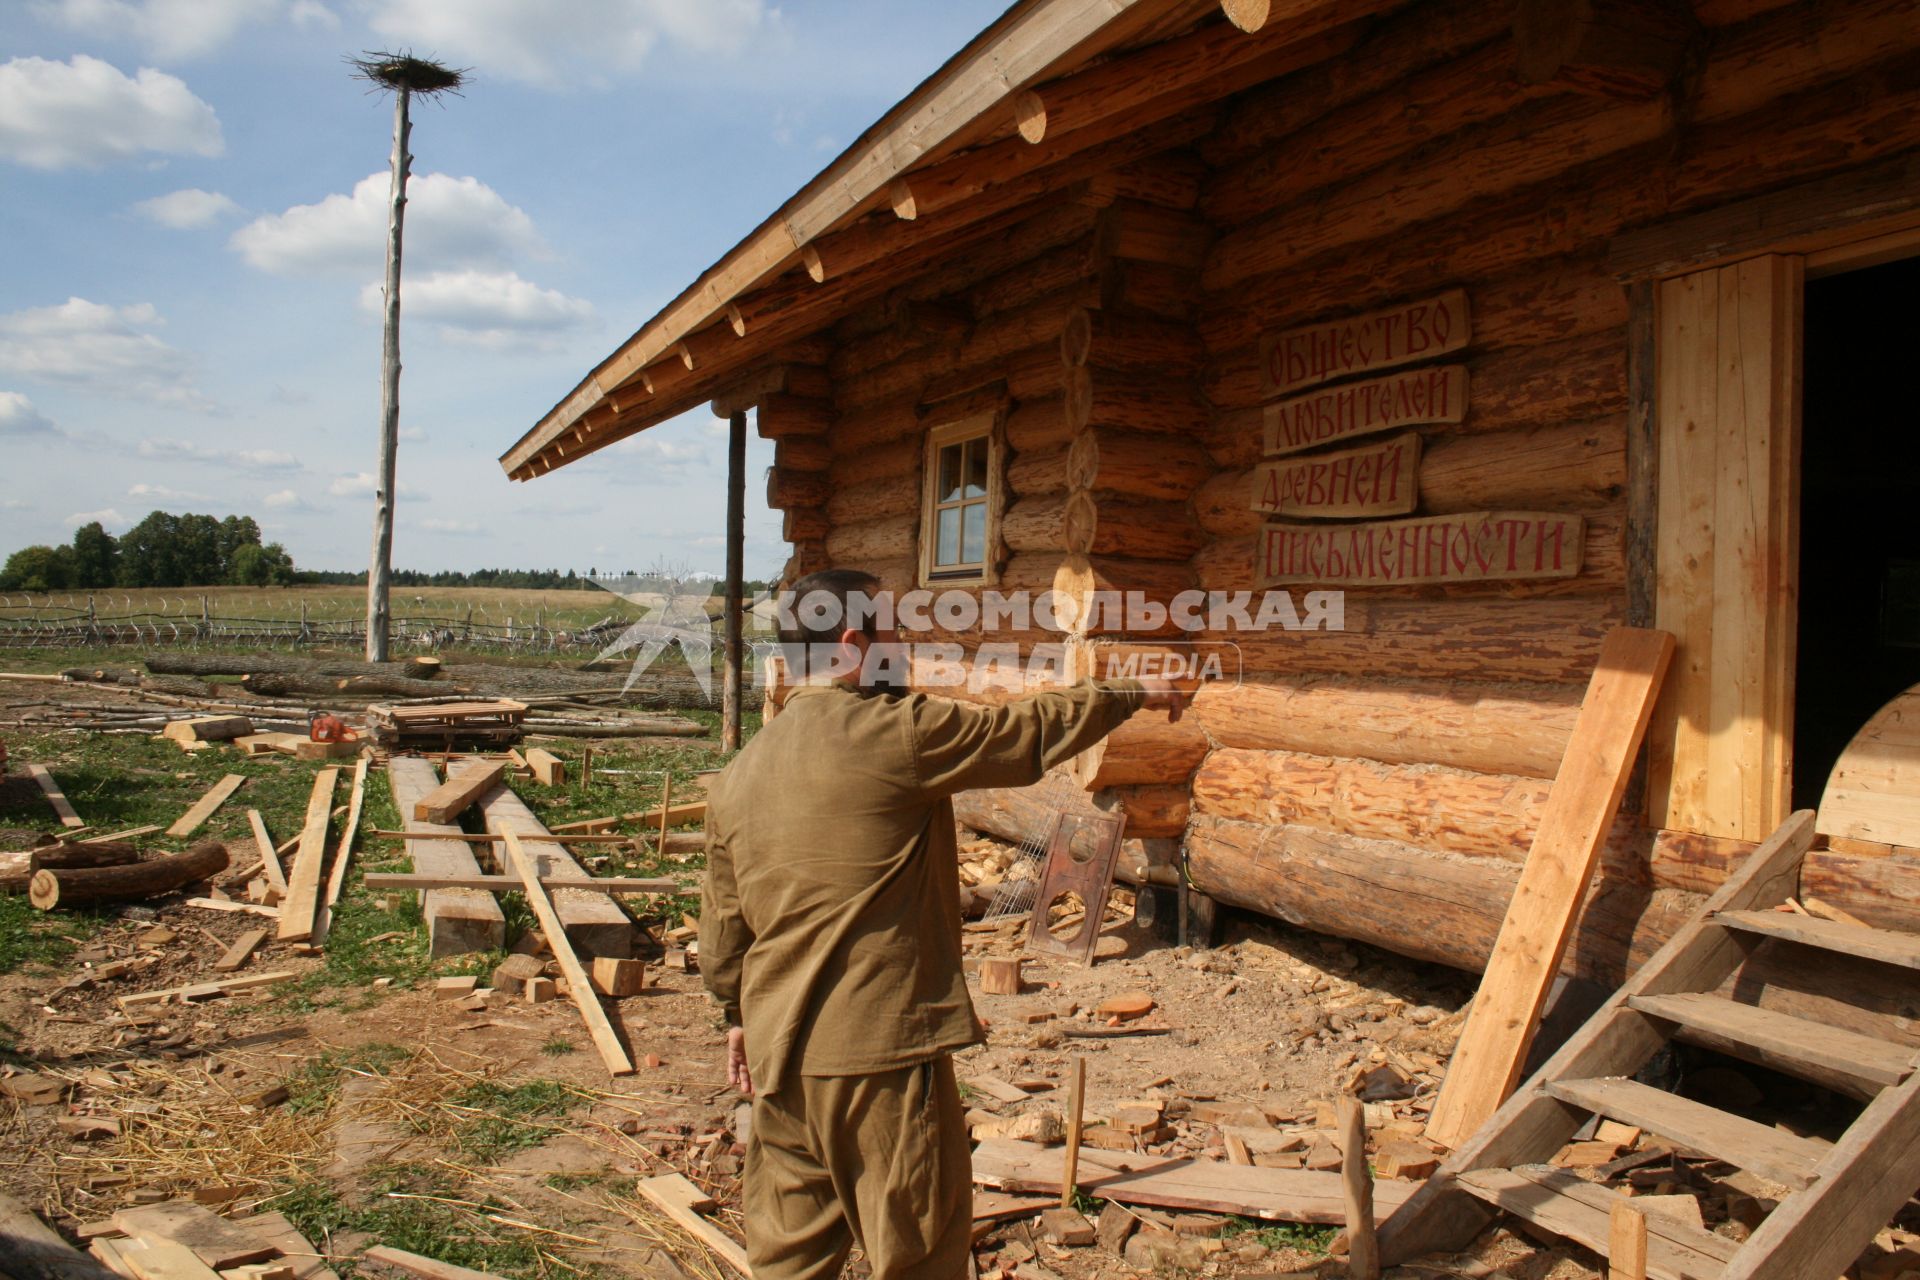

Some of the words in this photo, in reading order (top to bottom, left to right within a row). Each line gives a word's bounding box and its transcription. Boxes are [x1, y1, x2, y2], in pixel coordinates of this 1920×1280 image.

[1270, 301, 1450, 387] ОБЩЕСТВО
[1276, 368, 1449, 449] ЛЮБИТЕЛЕЙ
[1262, 444, 1403, 511] ДРЕВНЕЙ
[1265, 519, 1566, 581] ПИСЬМЕННОСТИ
